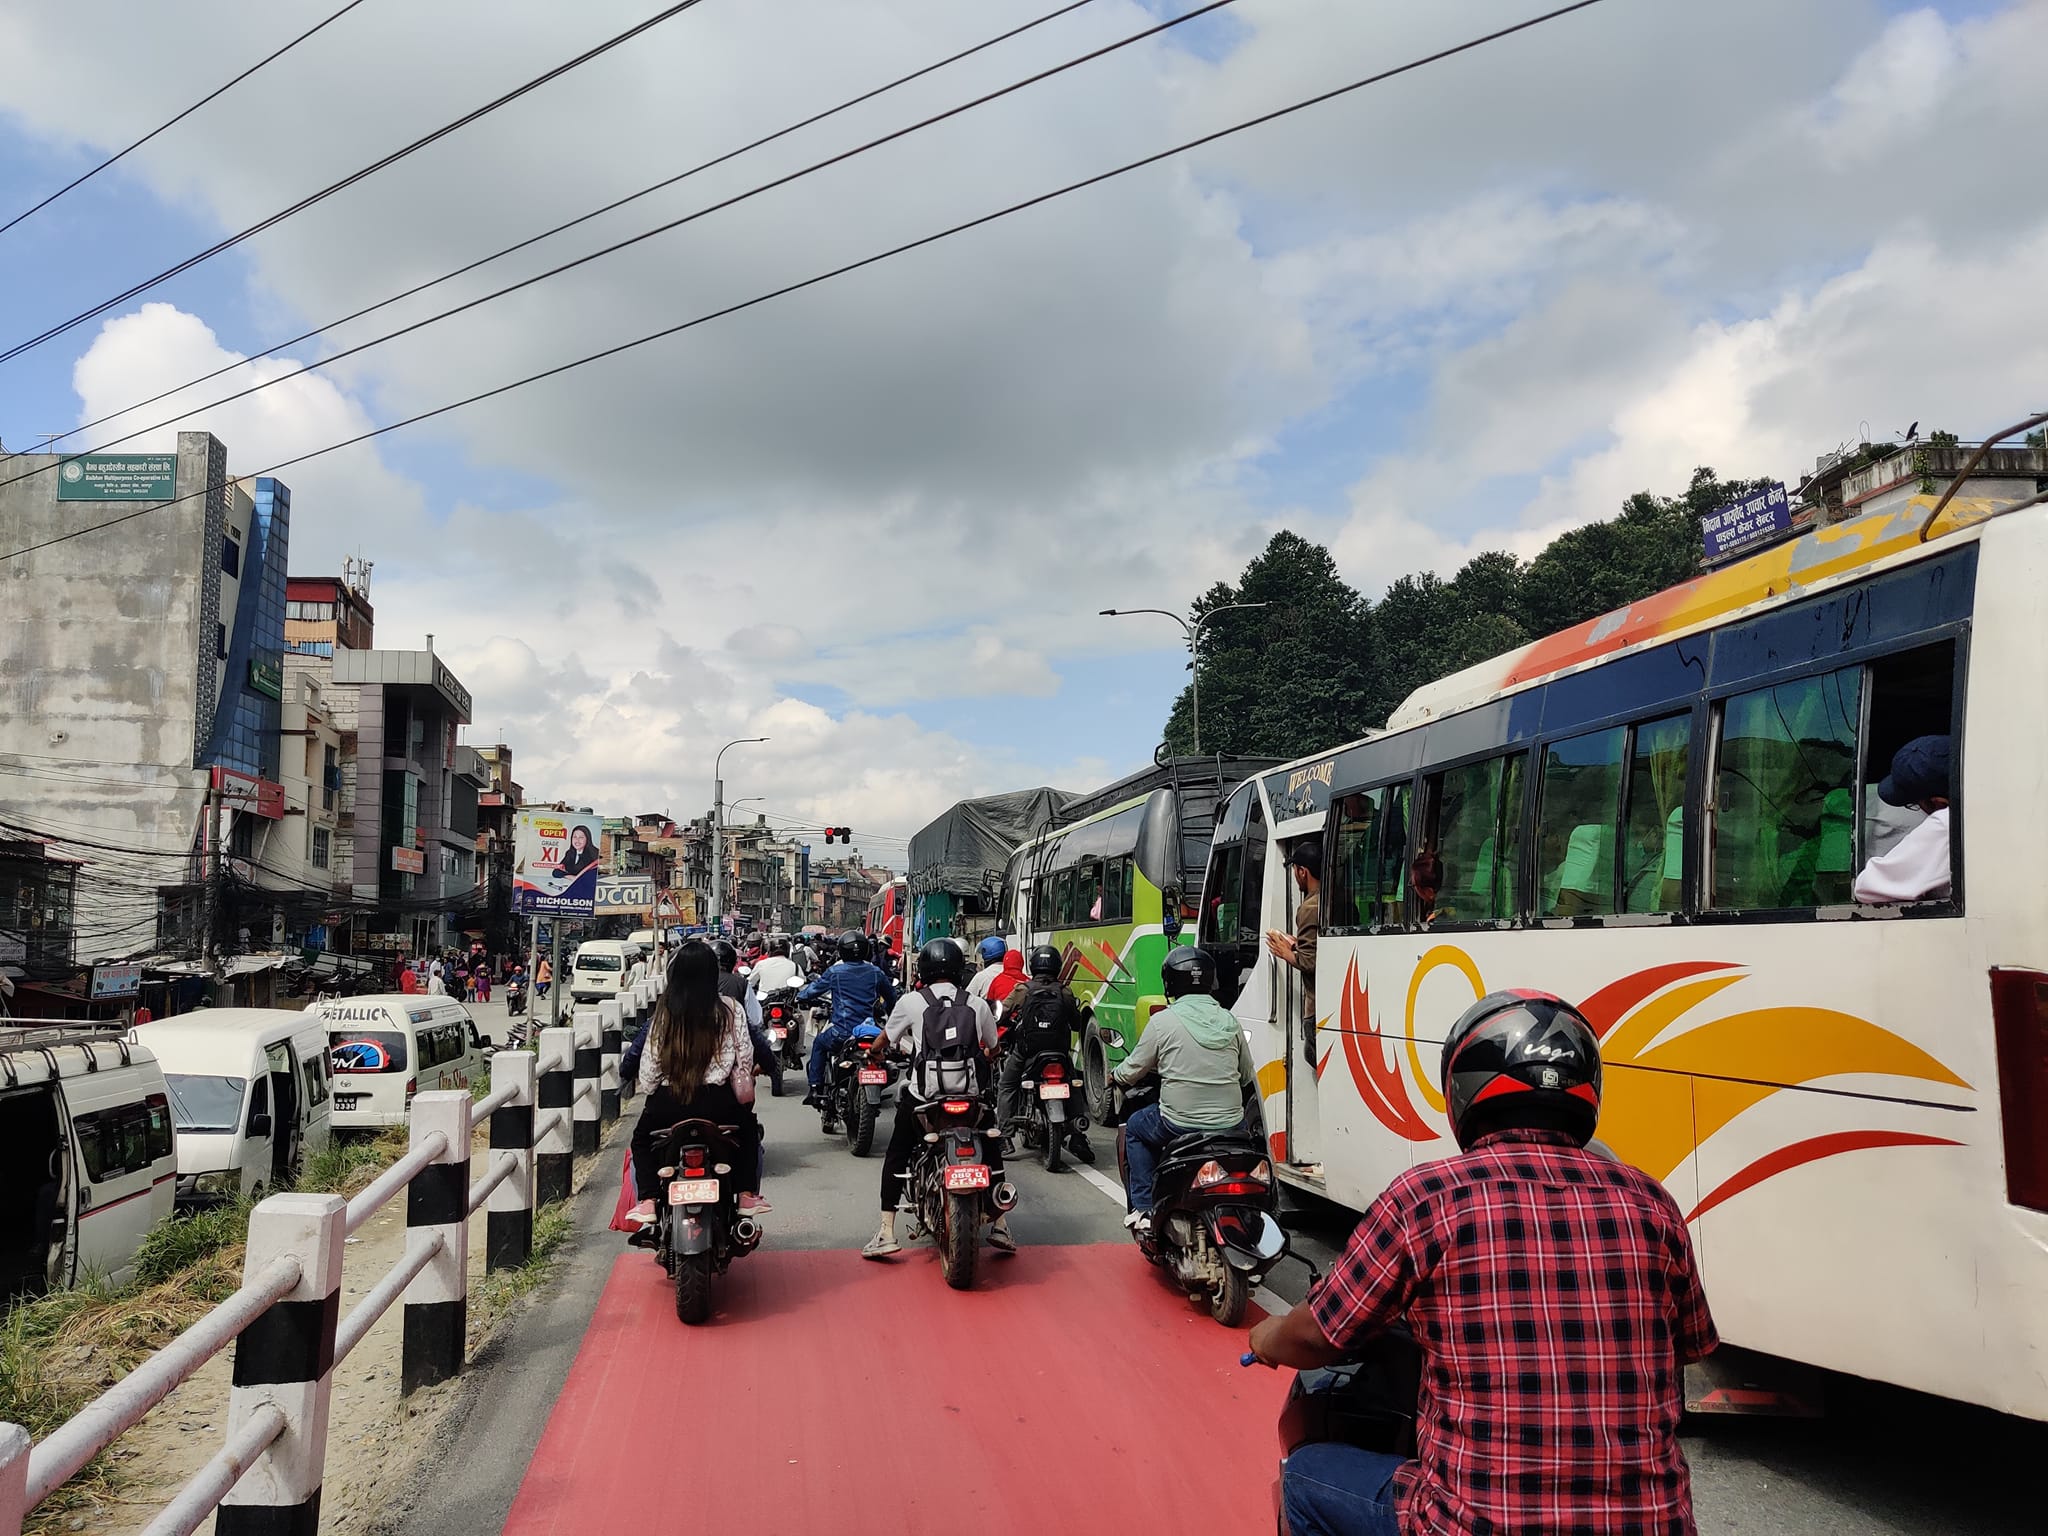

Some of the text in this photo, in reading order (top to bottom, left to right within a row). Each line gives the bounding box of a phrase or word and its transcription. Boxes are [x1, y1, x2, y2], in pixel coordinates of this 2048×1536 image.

[1703, 488, 1784, 534] निदान आयुर्वेद उपचार केन्द्र
[1288, 761, 1335, 796] WELCOME
[543, 829, 565, 837] OPEN
[541, 846, 559, 863] XI
[536, 896, 593, 907] NICHOLSON
